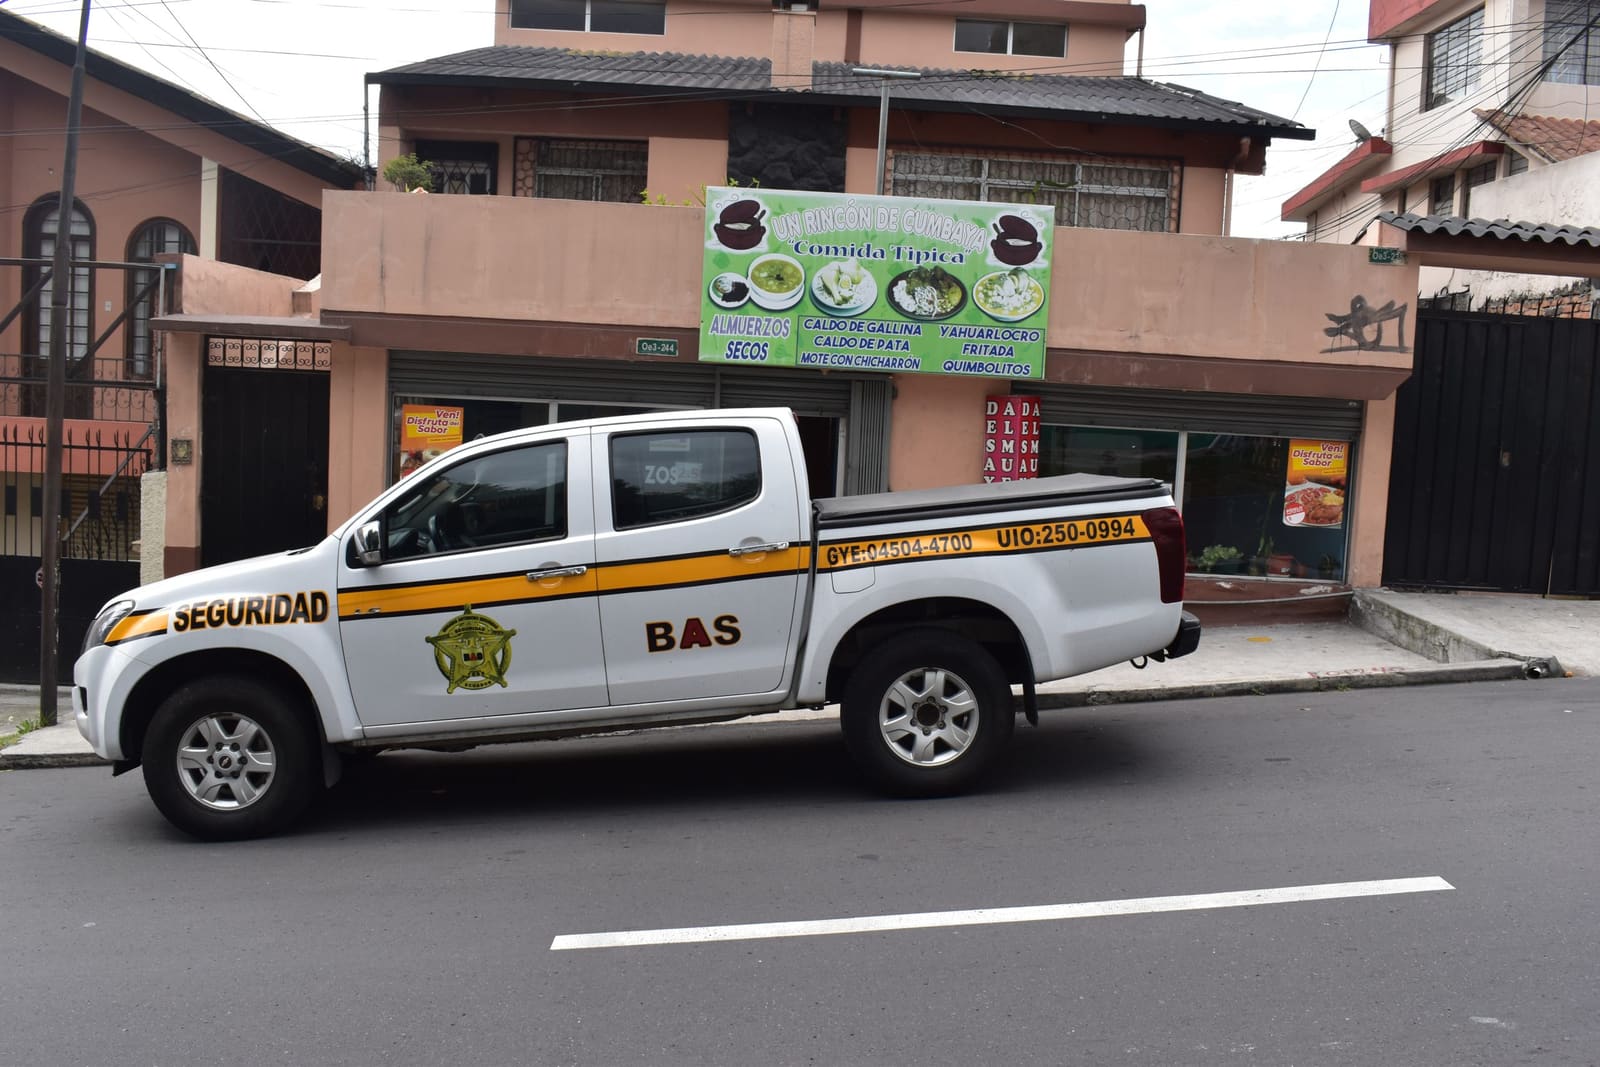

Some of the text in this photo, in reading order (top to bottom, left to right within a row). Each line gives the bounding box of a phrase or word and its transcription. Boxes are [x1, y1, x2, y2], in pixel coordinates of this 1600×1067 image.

[771, 200, 988, 253] UN RINCÓN DE CUMBAYA
[709, 315, 791, 338] ALMUERZOS
[804, 318, 922, 336] CALDO DE GALLINA
[939, 325, 1040, 342] YAHUARLOCRO
[725, 340, 769, 361] SECOS
[814, 335, 910, 352] CALDO DE PATA
[962, 343, 1015, 358] FRITADA
[800, 352, 921, 369] MOTE CON CHICHARRÓN
[943, 360, 1031, 376] QUIMBOLITOS
[406, 416, 449, 426] Disfruta
[435, 410, 460, 419] Ven!
[417, 425, 448, 434] Sabor
[1019, 402, 1030, 480] DESA
[1030, 402, 1041, 480] ALMU
[1321, 443, 1344, 453] Ven!
[1292, 449, 1333, 460] Disfruta
[1302, 458, 1332, 467] Sabor
[827, 518, 1136, 565] GYE:04504-4700 UIO:250-0994
[173, 590, 329, 632] SEGURIDAD
[645, 614, 741, 653] BAS
